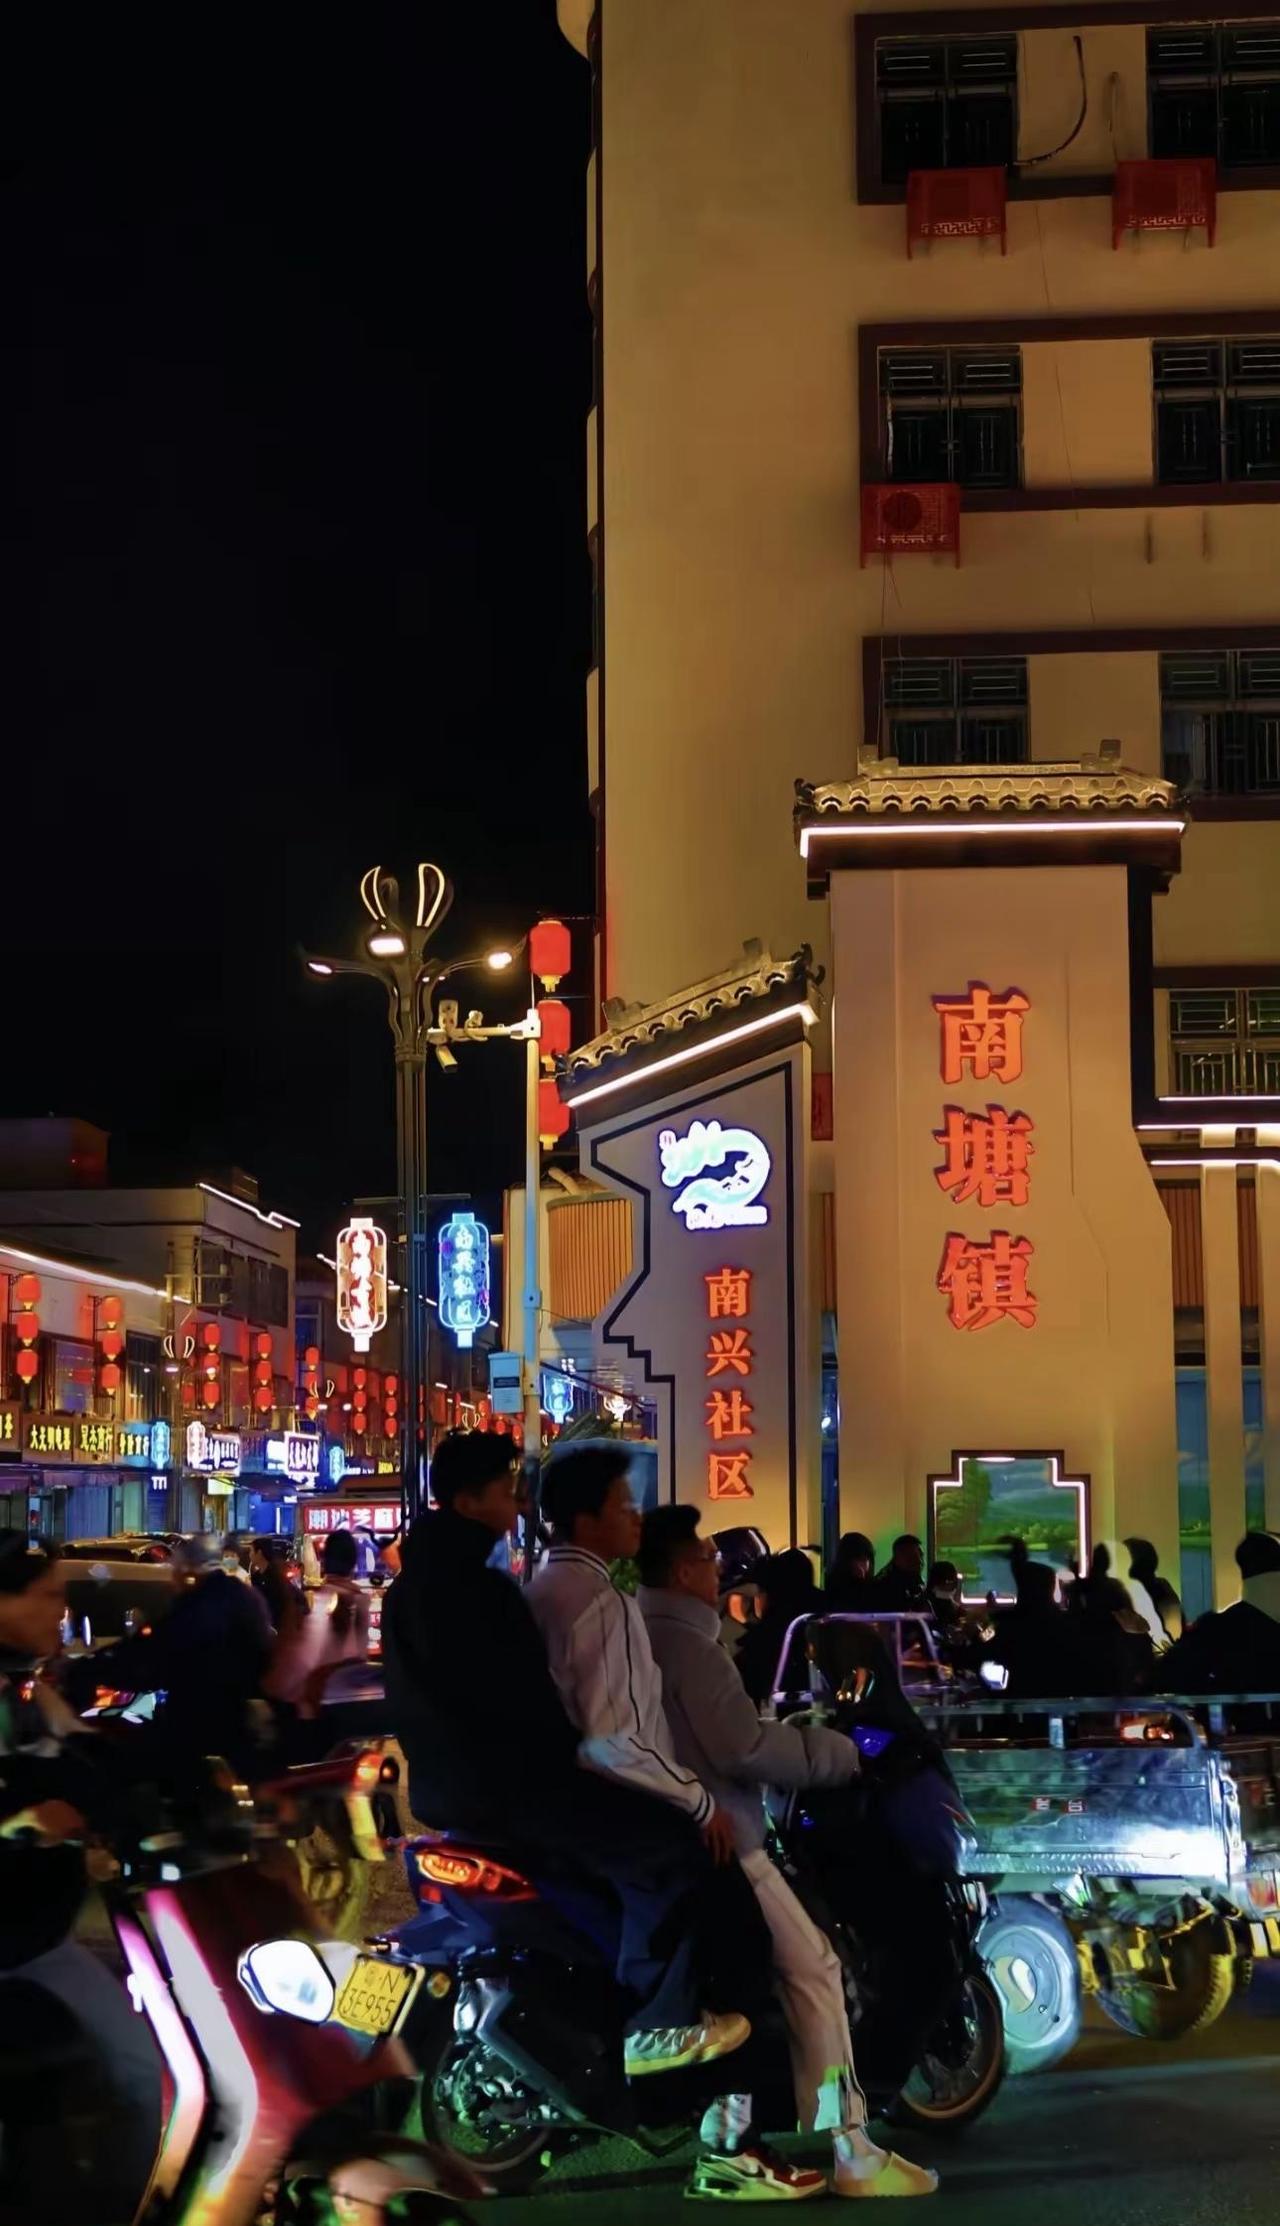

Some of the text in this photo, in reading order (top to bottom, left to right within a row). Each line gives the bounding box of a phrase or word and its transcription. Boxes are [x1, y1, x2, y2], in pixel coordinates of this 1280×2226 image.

[931, 980, 1038, 1332] 南塘镇
[703, 1267, 755, 1500] 南兴社区
